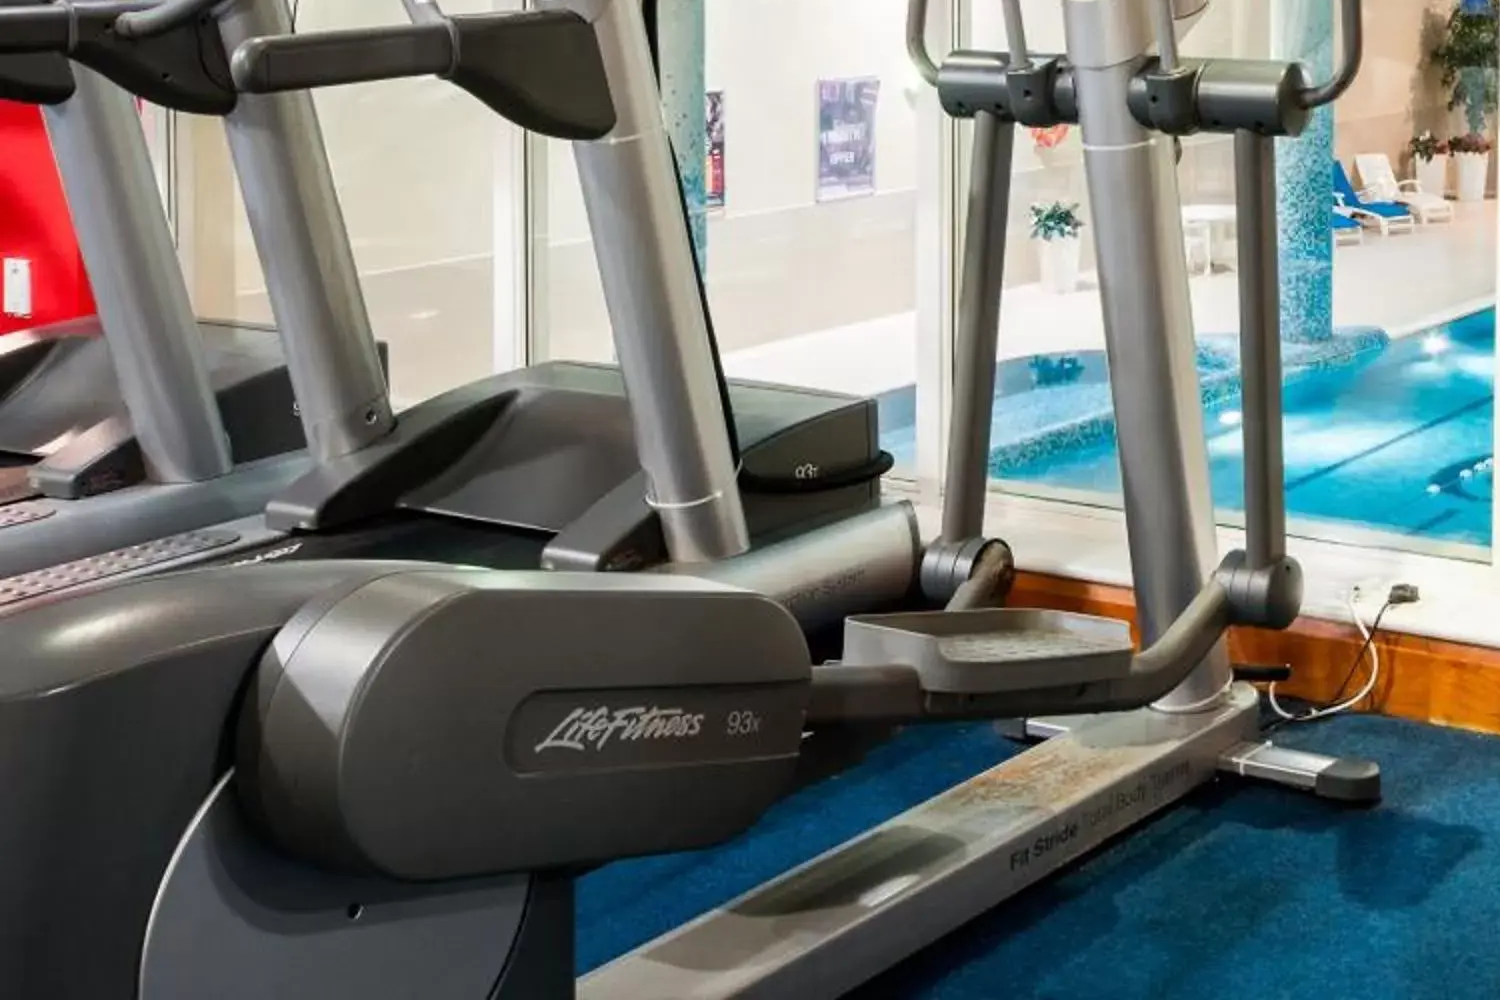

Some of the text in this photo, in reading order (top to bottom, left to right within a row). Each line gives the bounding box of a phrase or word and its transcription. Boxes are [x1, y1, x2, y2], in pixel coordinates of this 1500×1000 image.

[727, 711, 761, 735] 93x
[1009, 849, 1031, 871] Fit
[1033, 822, 1077, 858] Stride
